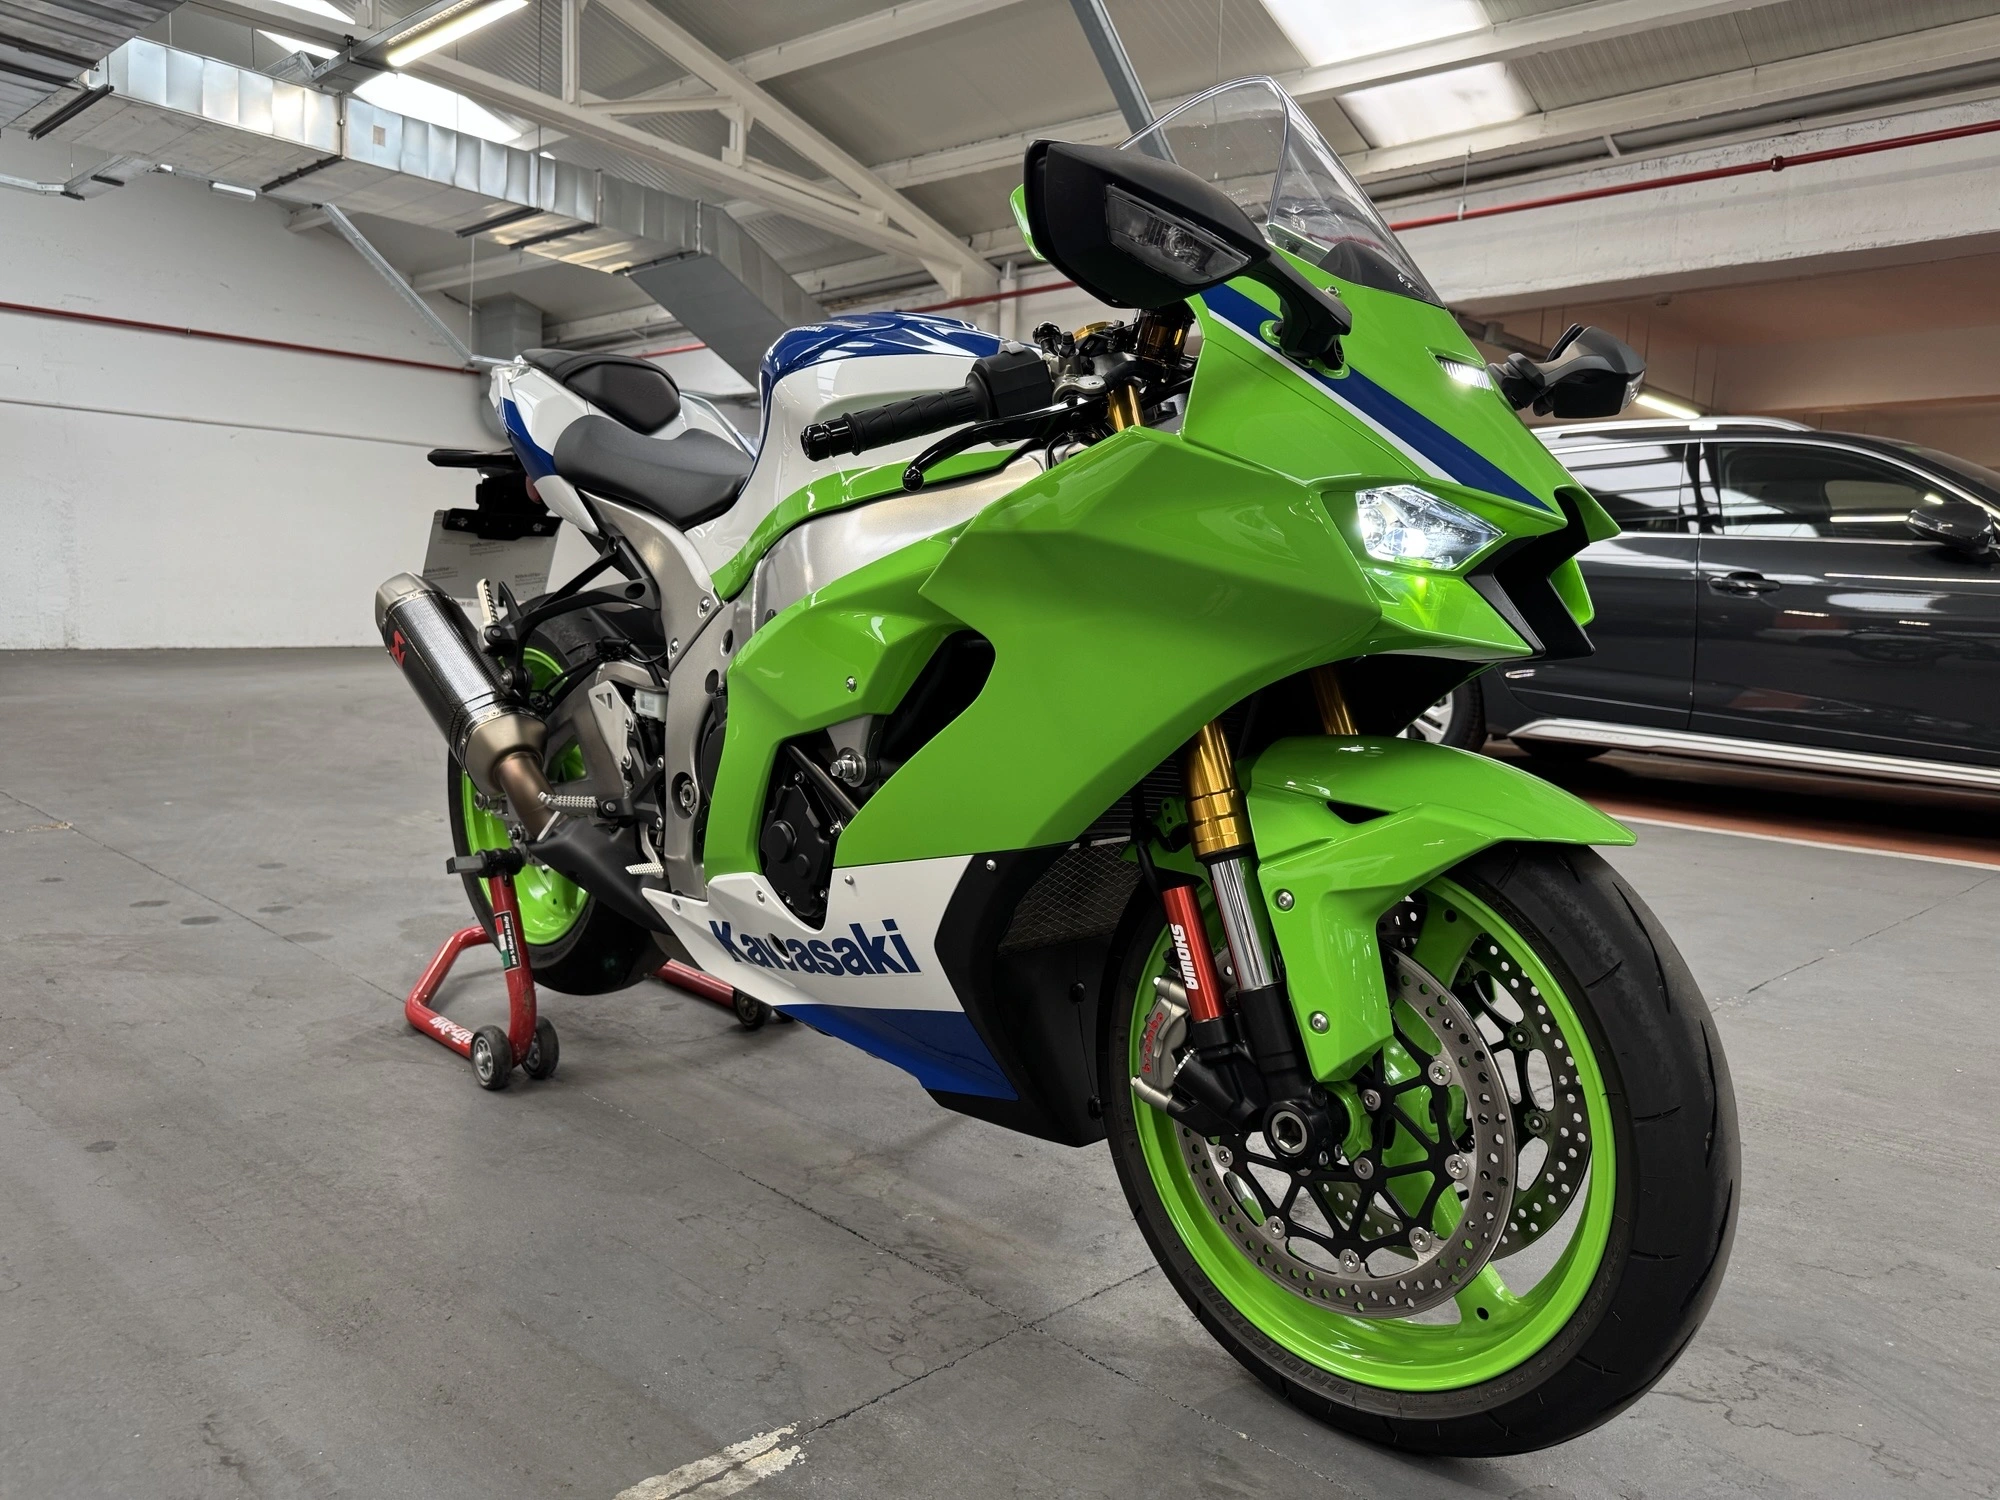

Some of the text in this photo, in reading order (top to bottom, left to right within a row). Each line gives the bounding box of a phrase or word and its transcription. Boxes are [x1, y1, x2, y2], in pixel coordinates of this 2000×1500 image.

[709, 918, 922, 976] Kawasaki
[1170, 923, 1199, 990] SHOWA
[1141, 1011, 1164, 1073] brembo
[1190, 1273, 1354, 1396] BRIDGESTONE
